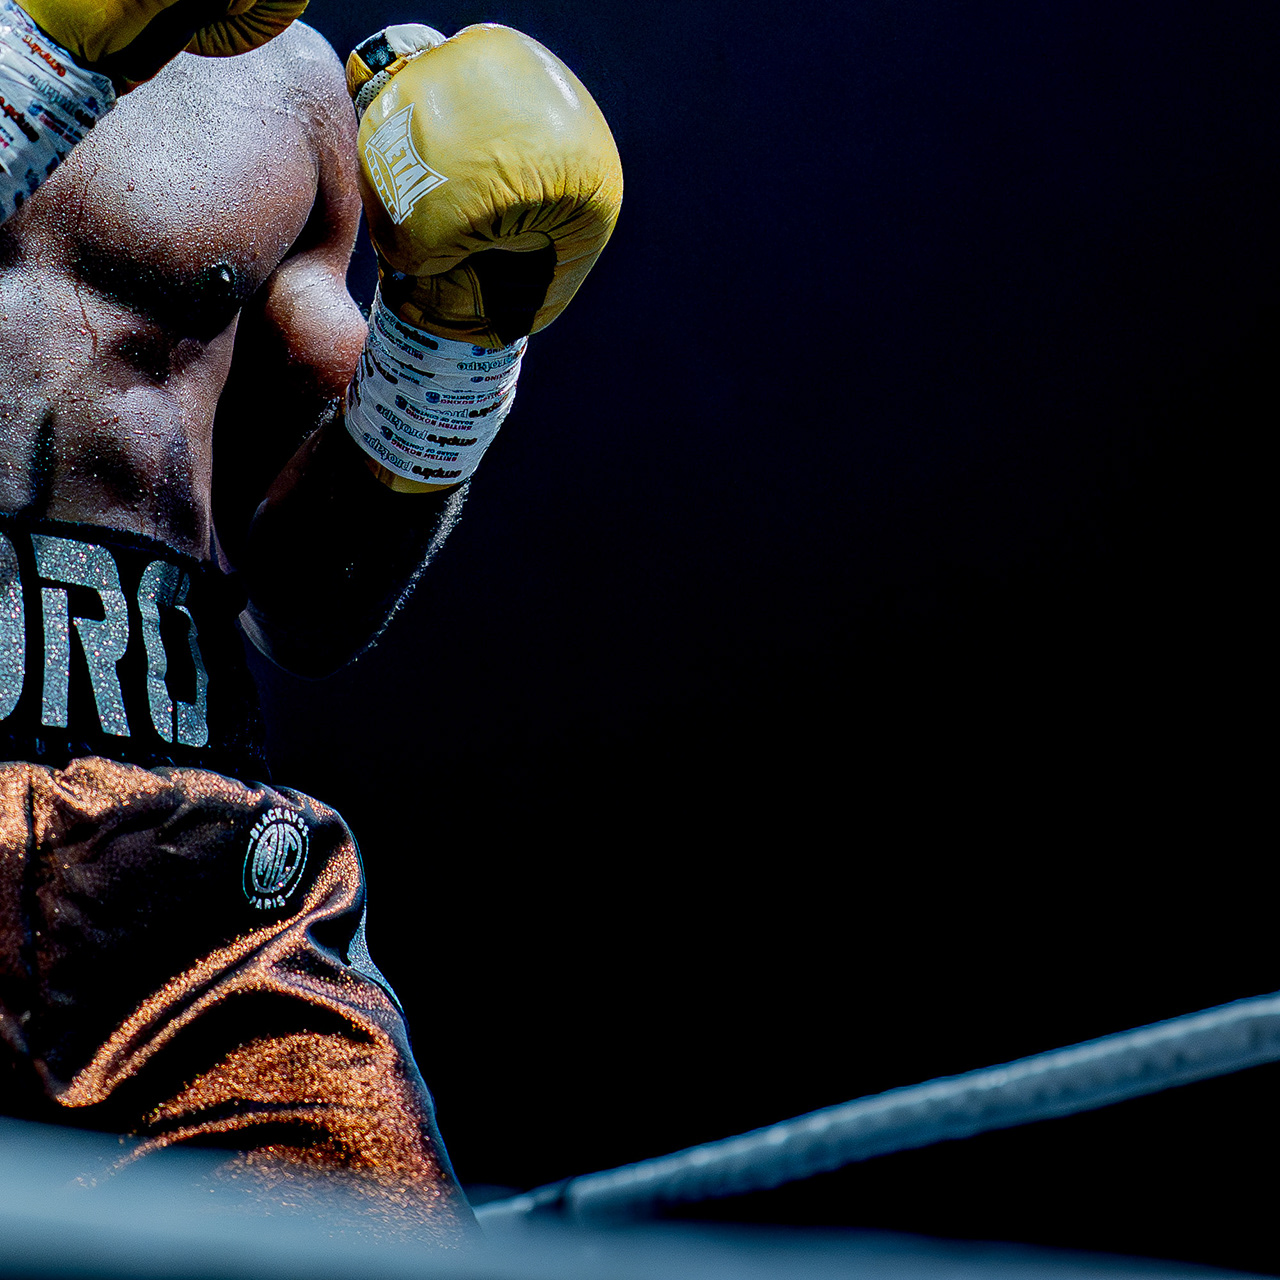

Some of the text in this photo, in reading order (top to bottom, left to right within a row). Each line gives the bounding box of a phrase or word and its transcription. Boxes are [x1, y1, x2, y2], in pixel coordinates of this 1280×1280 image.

[369, 110, 440, 216] METAL
[375, 403, 428, 440] protape
[405, 408, 437, 427] BOXING
[439, 421, 473, 431] BRITISH
[363, 432, 413, 472] protape
[391, 438, 458, 462] BRITISH BOXING
